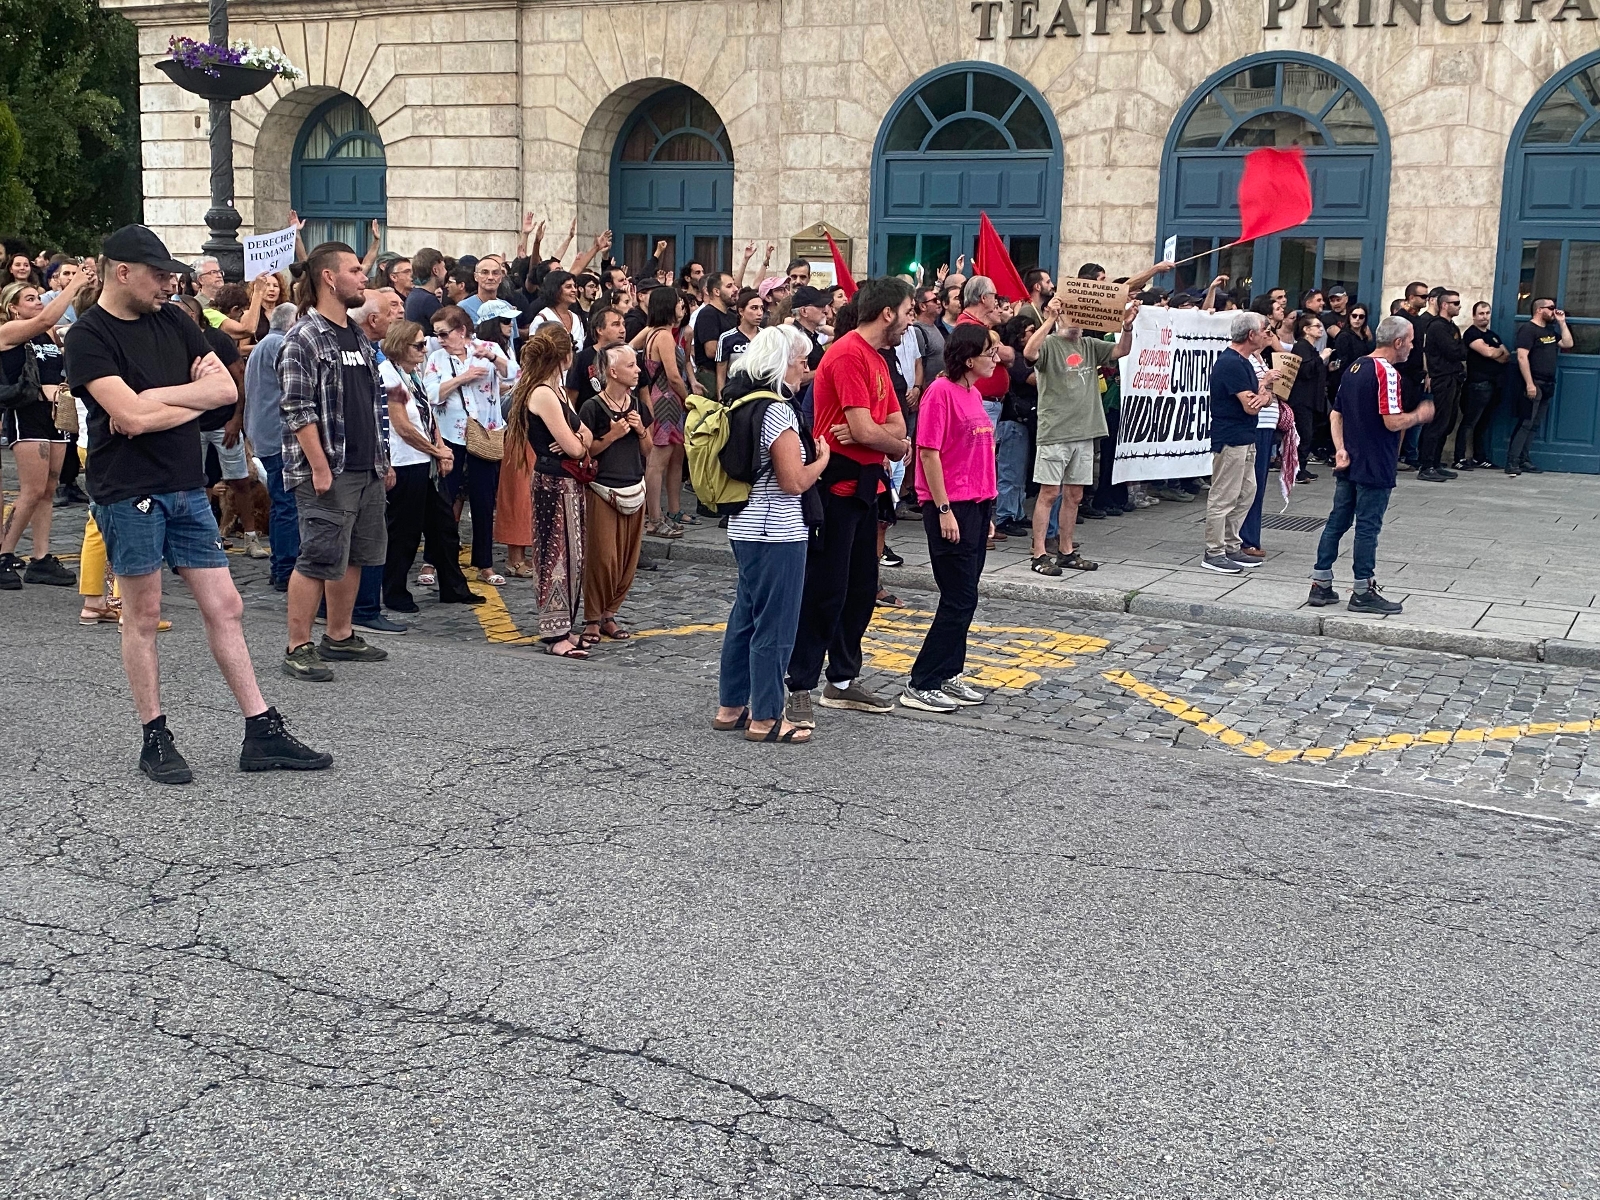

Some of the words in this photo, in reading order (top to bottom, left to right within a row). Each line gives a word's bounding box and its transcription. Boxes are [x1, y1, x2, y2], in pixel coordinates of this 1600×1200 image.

[970, 0, 1212, 41] TEATRO
[247, 229, 295, 250] DERECHOS
[250, 242, 293, 261] HUMANOS
[1067, 288, 1105, 298] SOLIDARIO
[1092, 283, 1120, 292] PUEBLO
[1077, 297, 1102, 305] CEUTA,
[1066, 310, 1121, 323] INTERNACIONAL
[1071, 318, 1103, 327] FASCISTA
[1172, 395, 1197, 442] DE
[1196, 394, 1212, 442] CL
